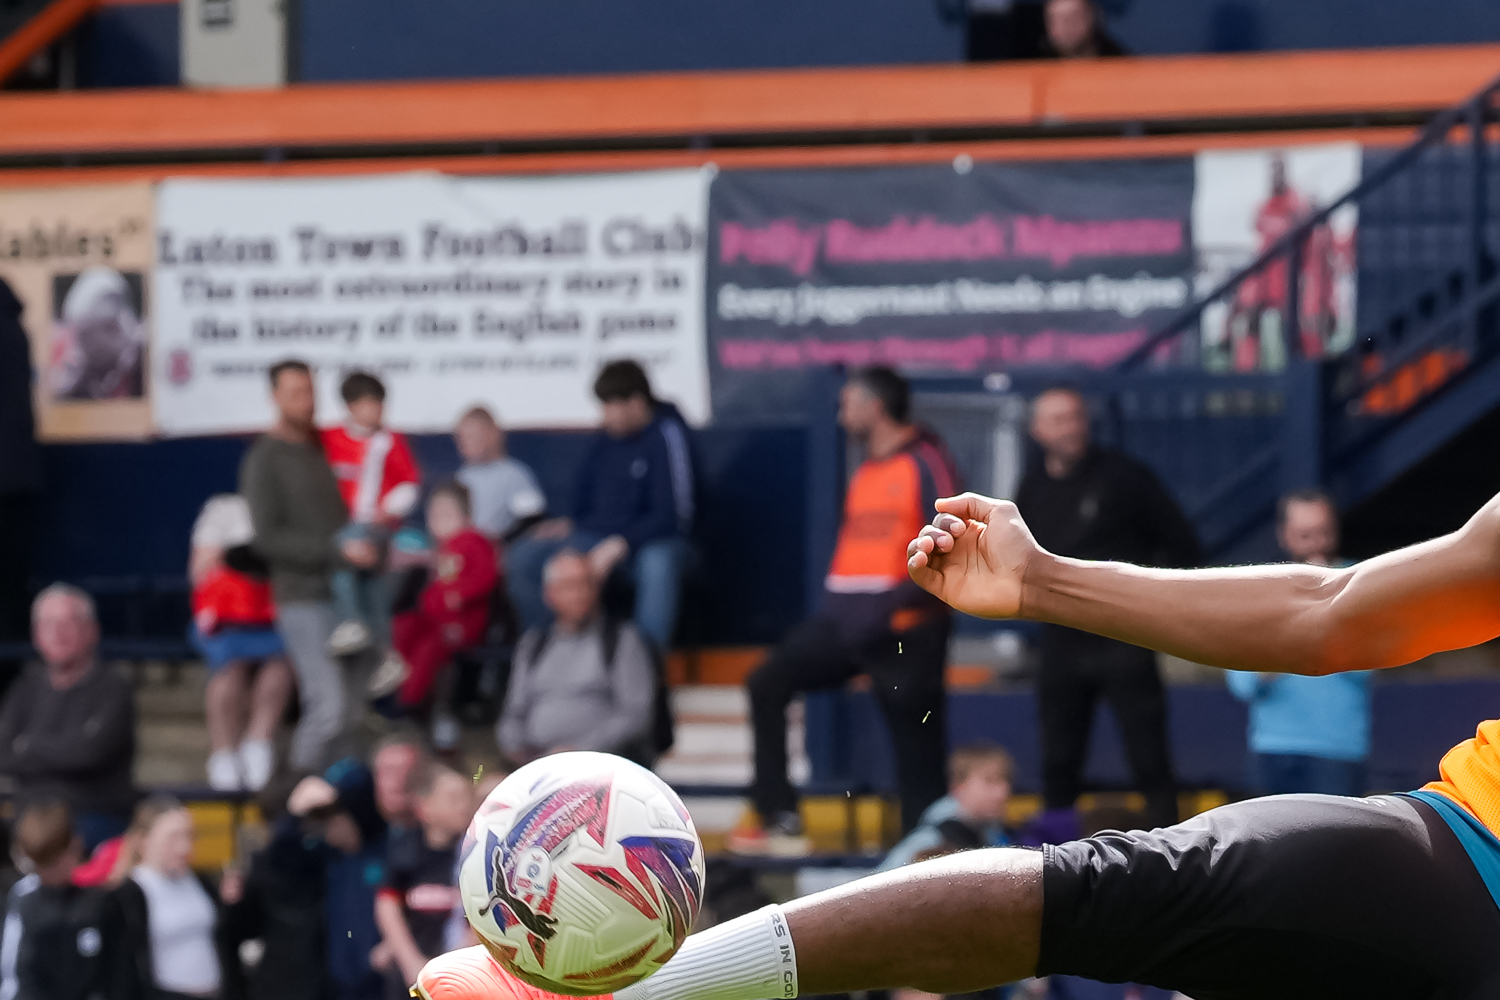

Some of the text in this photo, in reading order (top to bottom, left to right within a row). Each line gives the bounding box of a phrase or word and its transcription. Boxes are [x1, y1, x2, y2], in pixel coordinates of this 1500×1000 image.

[157, 213, 701, 268] Luton Town Football Club
[179, 271, 239, 304] The
[331, 268, 554, 305] extraordinary
[718, 274, 1187, 324] Every Juggernaut Needs an Engine
[252, 311, 364, 349] history
[472, 305, 587, 347] English
[596, 309, 682, 346] game
[779, 944, 792, 964] IN
